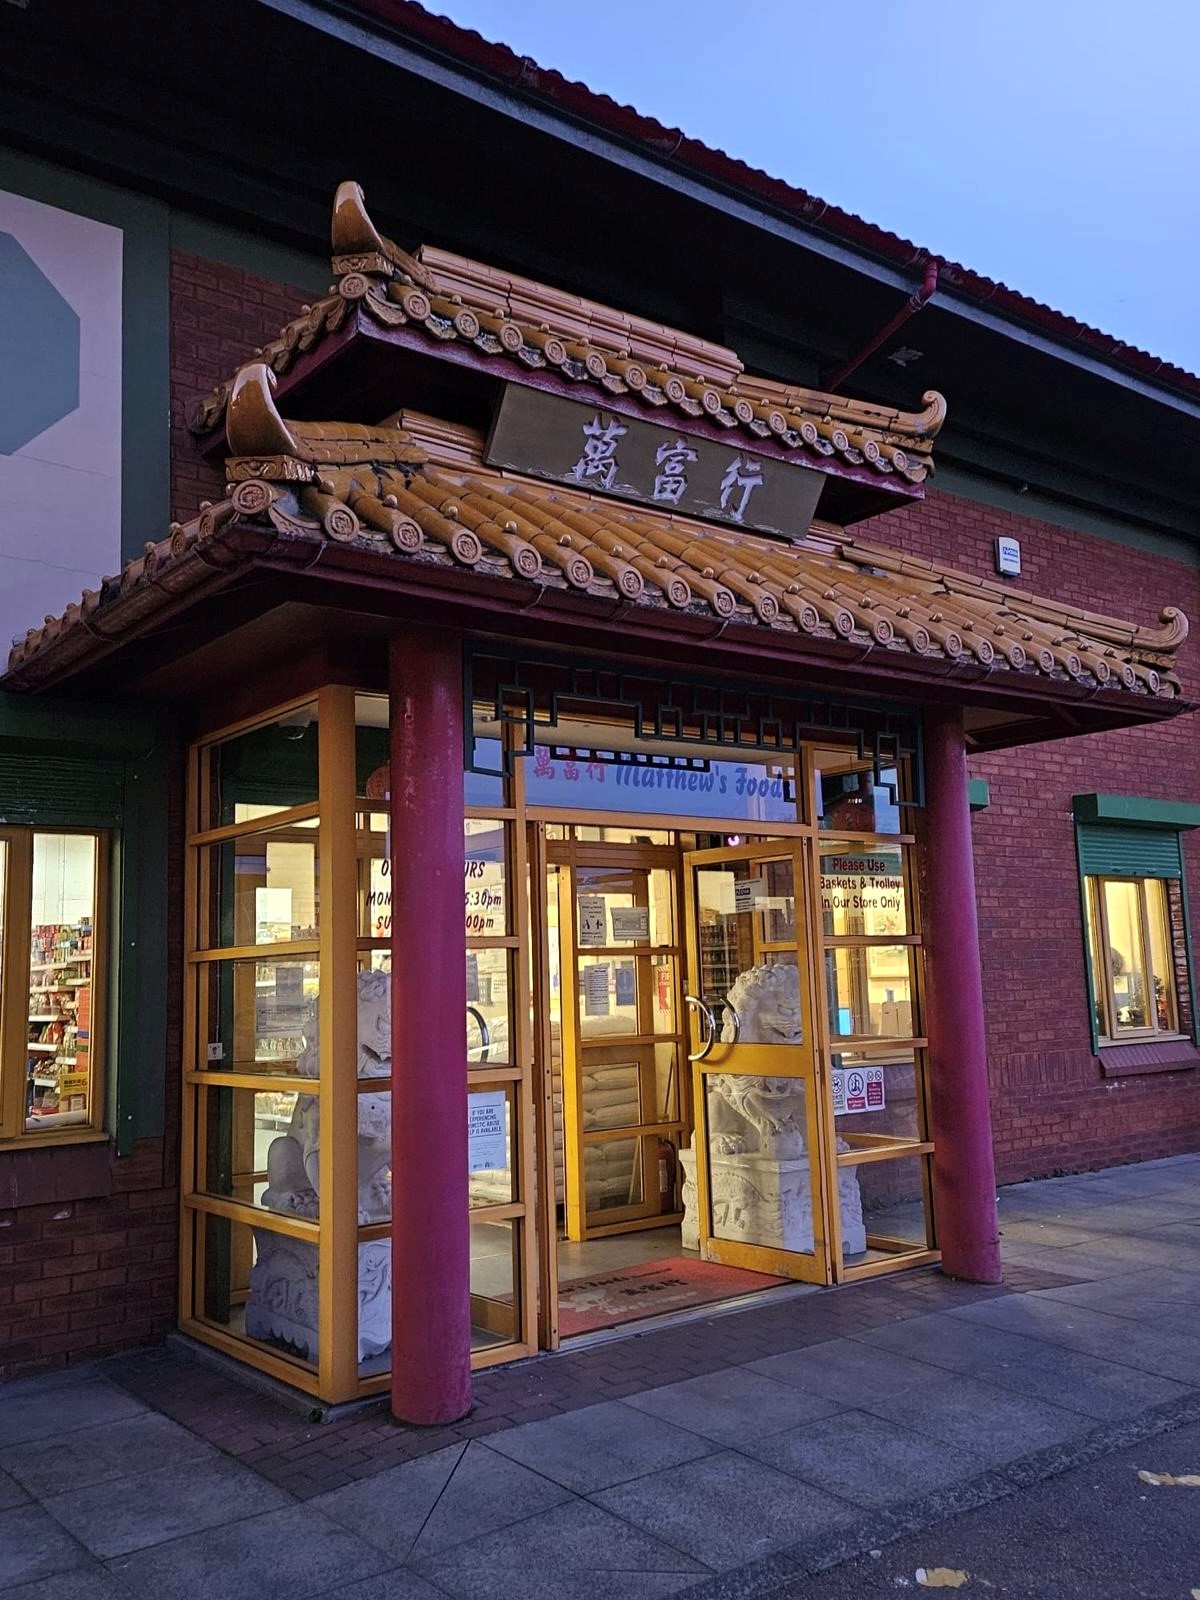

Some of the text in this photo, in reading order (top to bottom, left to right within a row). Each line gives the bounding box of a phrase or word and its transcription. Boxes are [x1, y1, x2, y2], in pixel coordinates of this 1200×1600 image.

[571, 412, 765, 522] 萬富行
[615, 760, 727, 794] Matthew's
[833, 858, 885, 872] Please Use
[820, 876, 857, 889] Baskets
[860, 877, 866, 889] &
[821, 896, 900, 912] In Our Store Only
